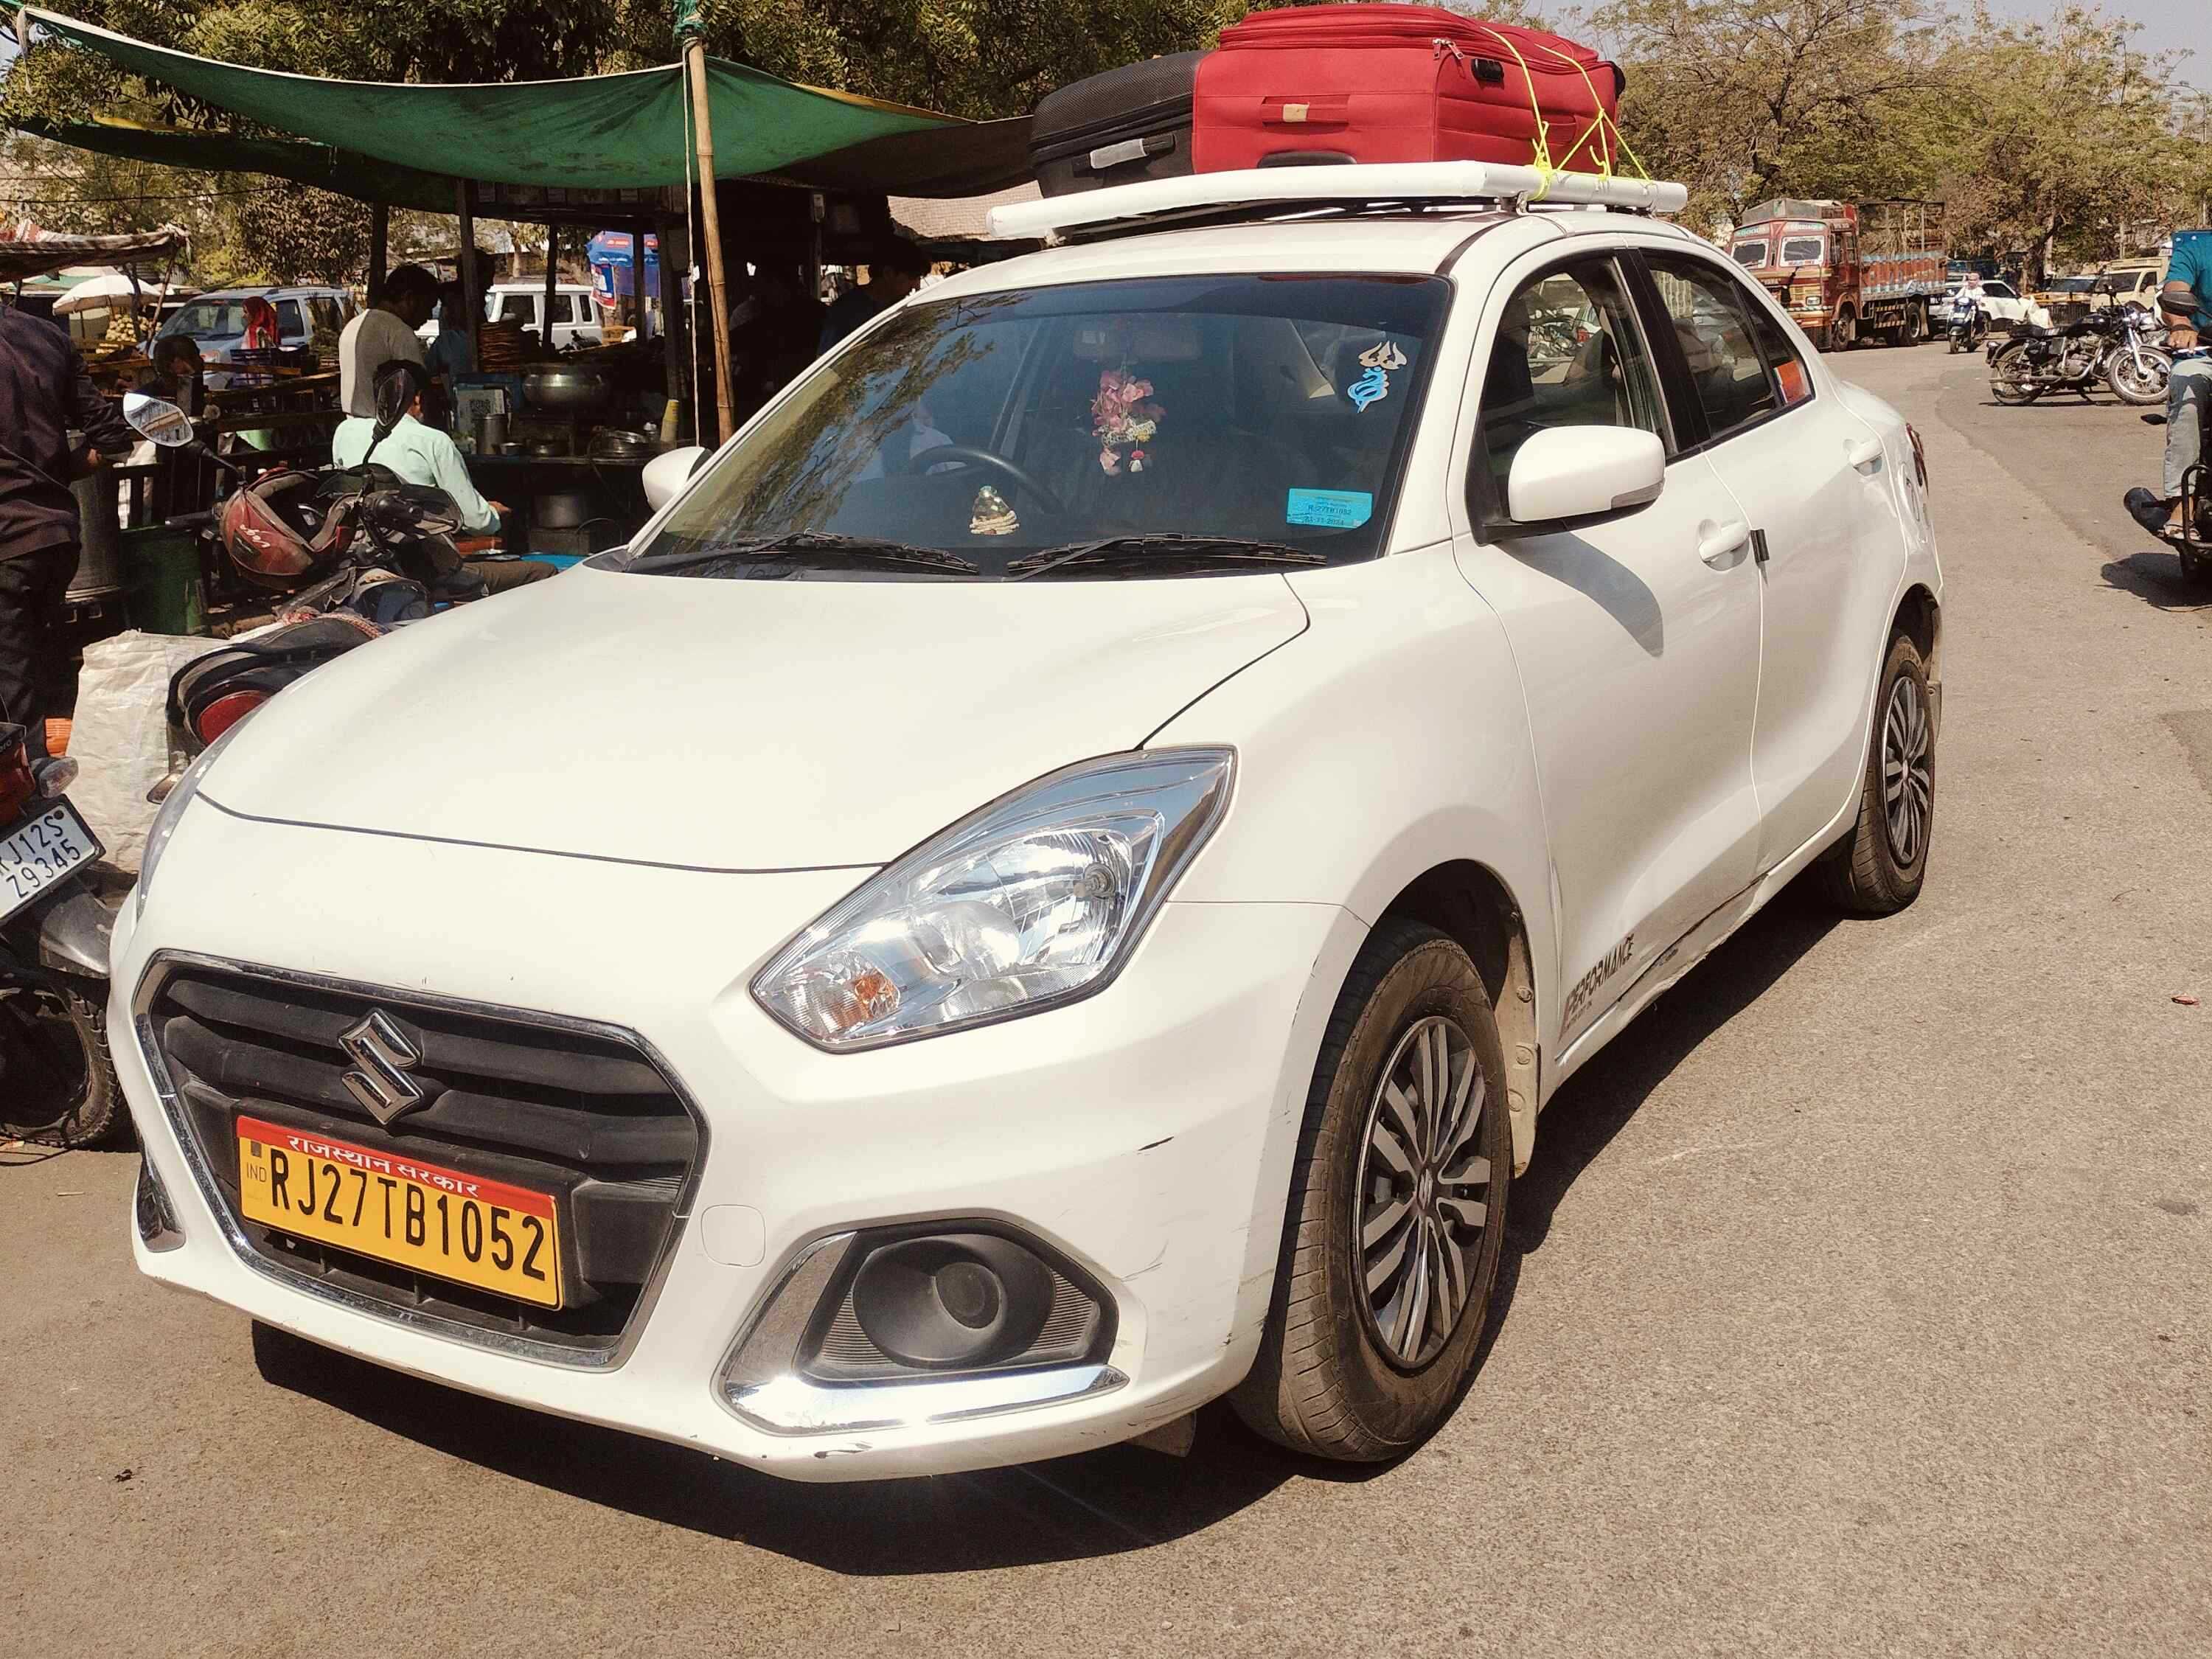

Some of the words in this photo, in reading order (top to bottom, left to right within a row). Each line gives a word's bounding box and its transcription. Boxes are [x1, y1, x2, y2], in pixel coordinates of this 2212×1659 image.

[6, 838, 80, 898] Z9345
[246, 1161, 267, 1183] IND
[287, 1135, 392, 1174] राजस्थान
[396, 1162, 481, 1197] सरकार
[270, 1147, 546, 1281] RJ27TB1052
